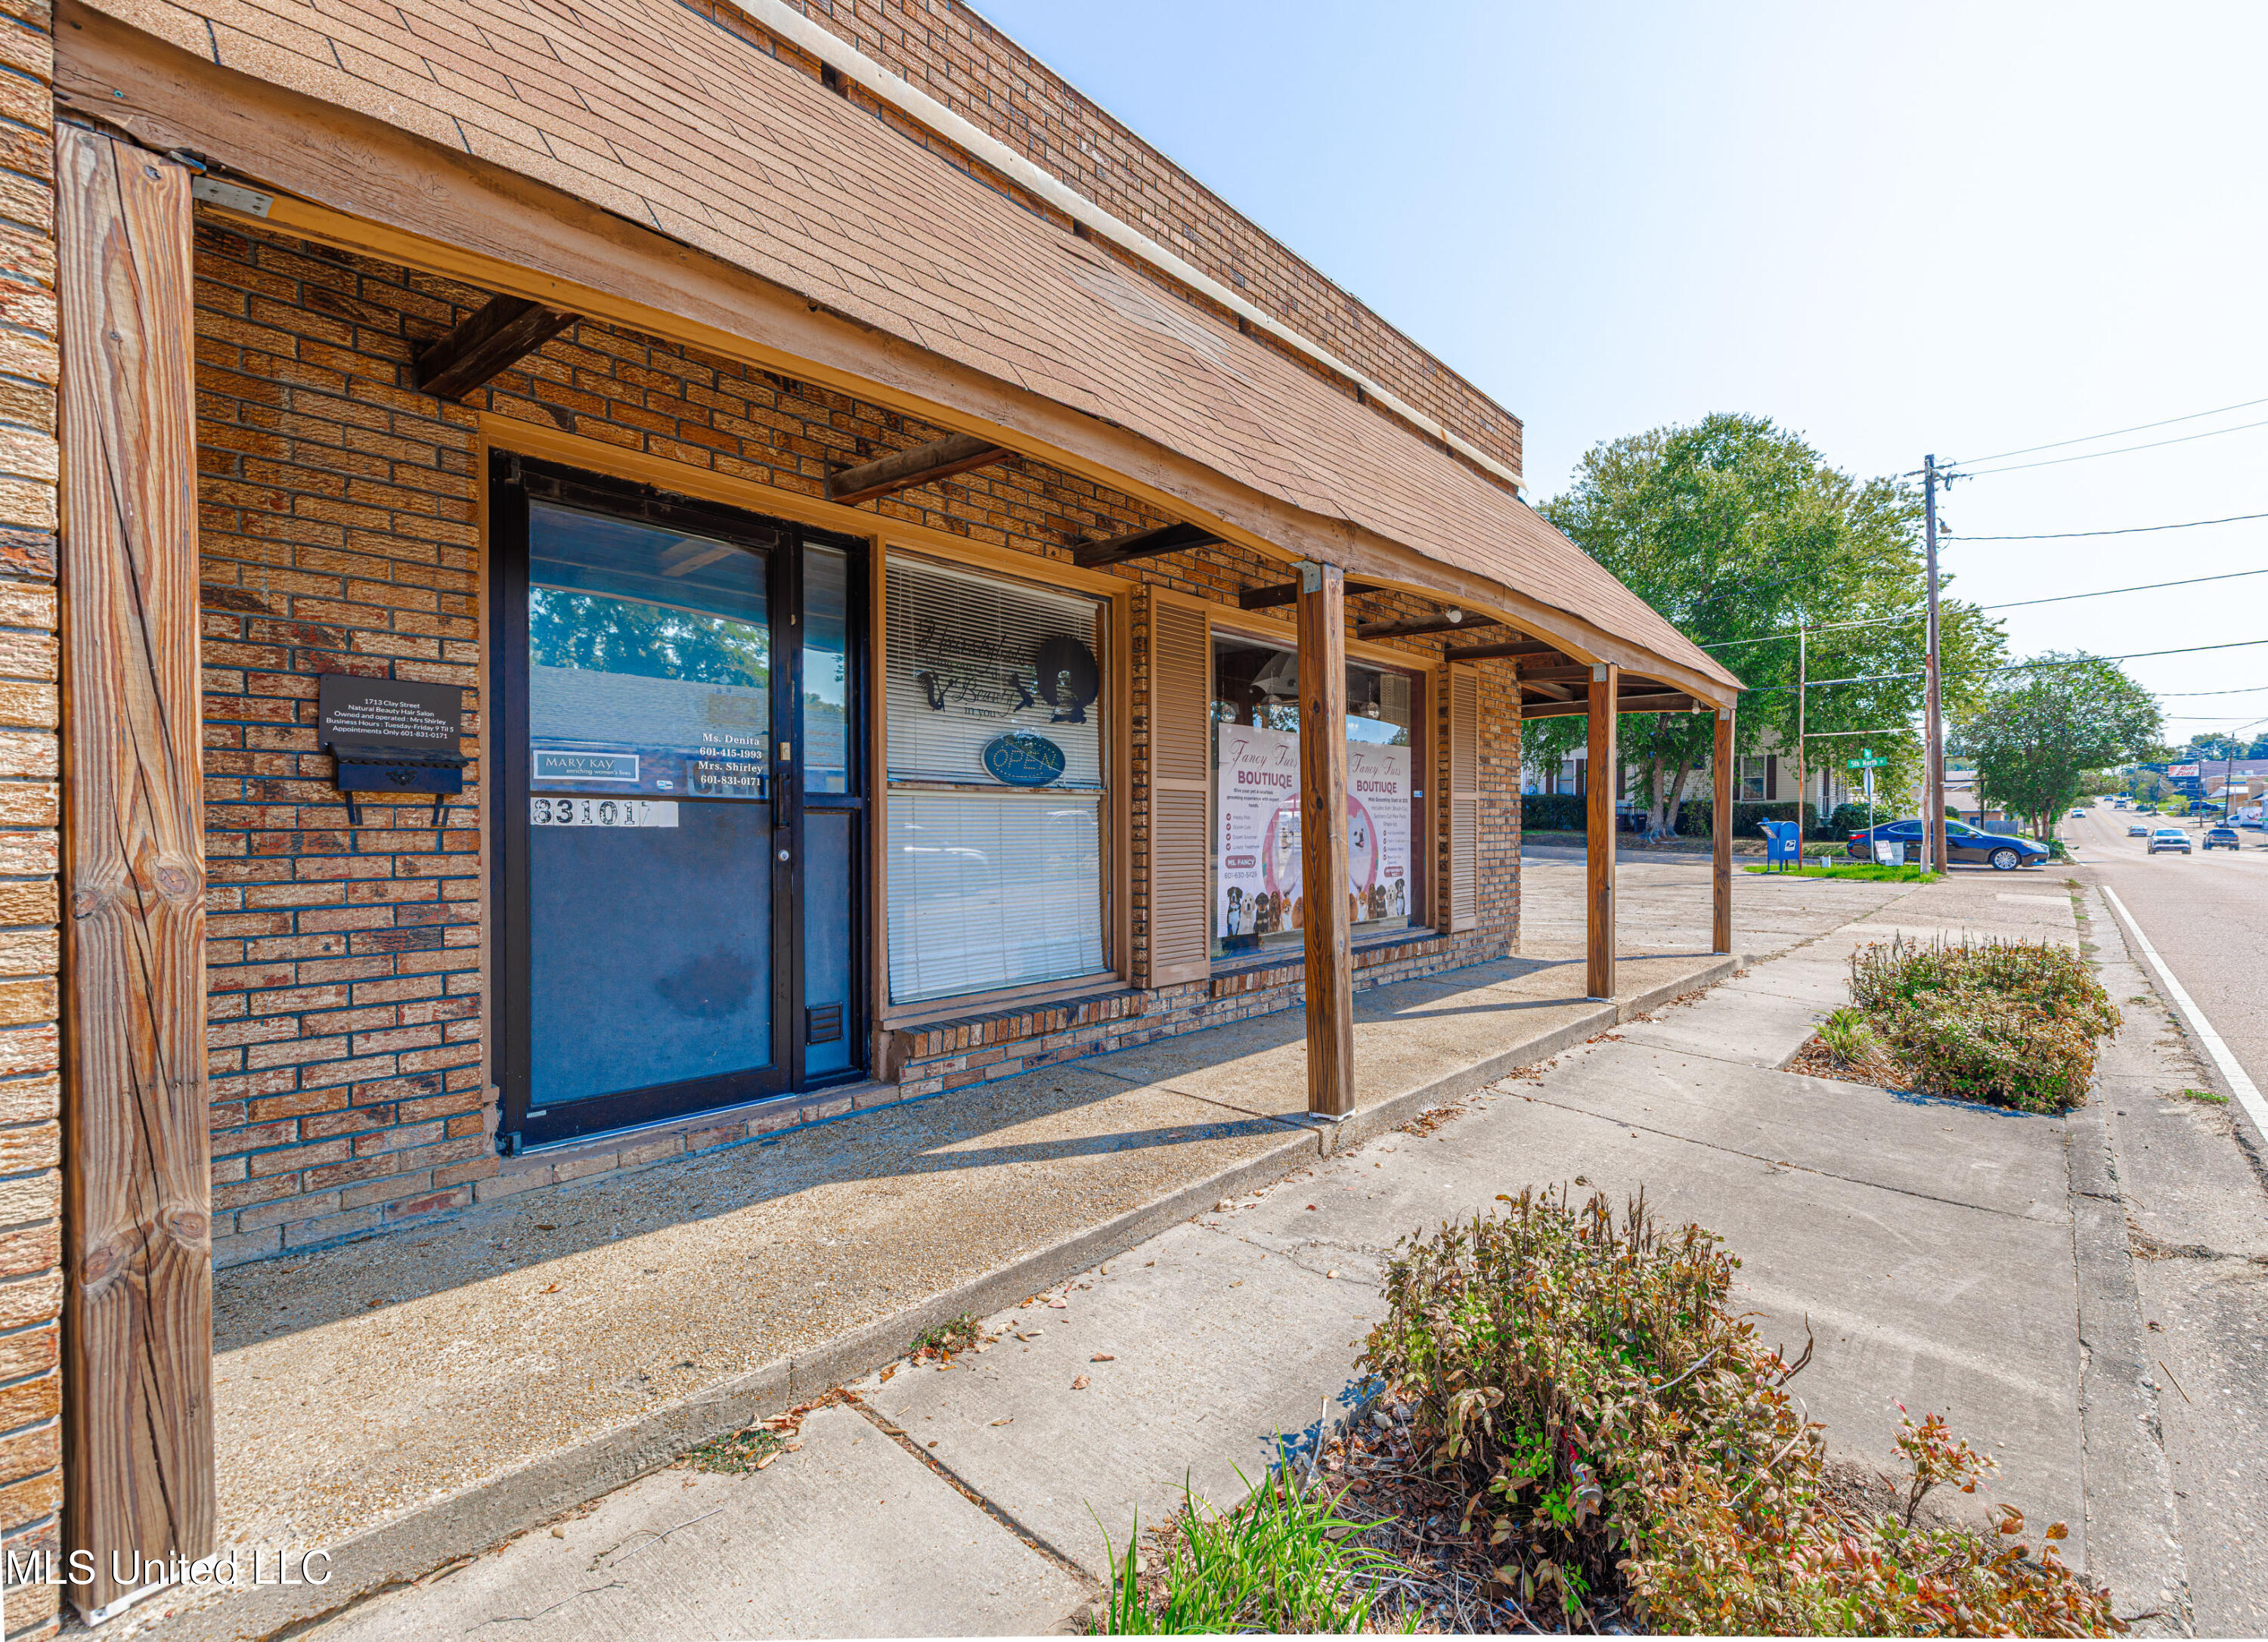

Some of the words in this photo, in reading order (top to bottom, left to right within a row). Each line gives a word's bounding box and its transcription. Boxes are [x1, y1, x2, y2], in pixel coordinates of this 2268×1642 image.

[348, 704, 374, 712] Natural
[964, 702, 974, 714] in
[978, 709, 996, 720] you
[385, 722, 434, 732] Tuesday-Friday
[424, 717, 447, 726] Shirley
[333, 725, 382, 734] Appointments
[400, 730, 448, 739] 601-831-0171
[702, 733, 721, 743] Ms.
[724, 734, 761, 745] Denita
[699, 747, 762, 759] 601-415-1993
[993, 748, 1057, 771] OPEN
[1228, 738, 1268, 775] Fancy
[1272, 743, 1298, 768] Furs
[546, 757, 586, 769] MARY
[590, 759, 615, 770] KAY
[698, 761, 723, 771] Mrs.
[725, 762, 763, 775] Shirley
[1351, 752, 1380, 779] Fancy
[1382, 756, 1402, 776] Furs
[700, 775, 761, 786] 601-831-0171
[1238, 770, 1293, 789] BOUTIUQE
[1356, 779, 1397, 795] BOUTIUQE
